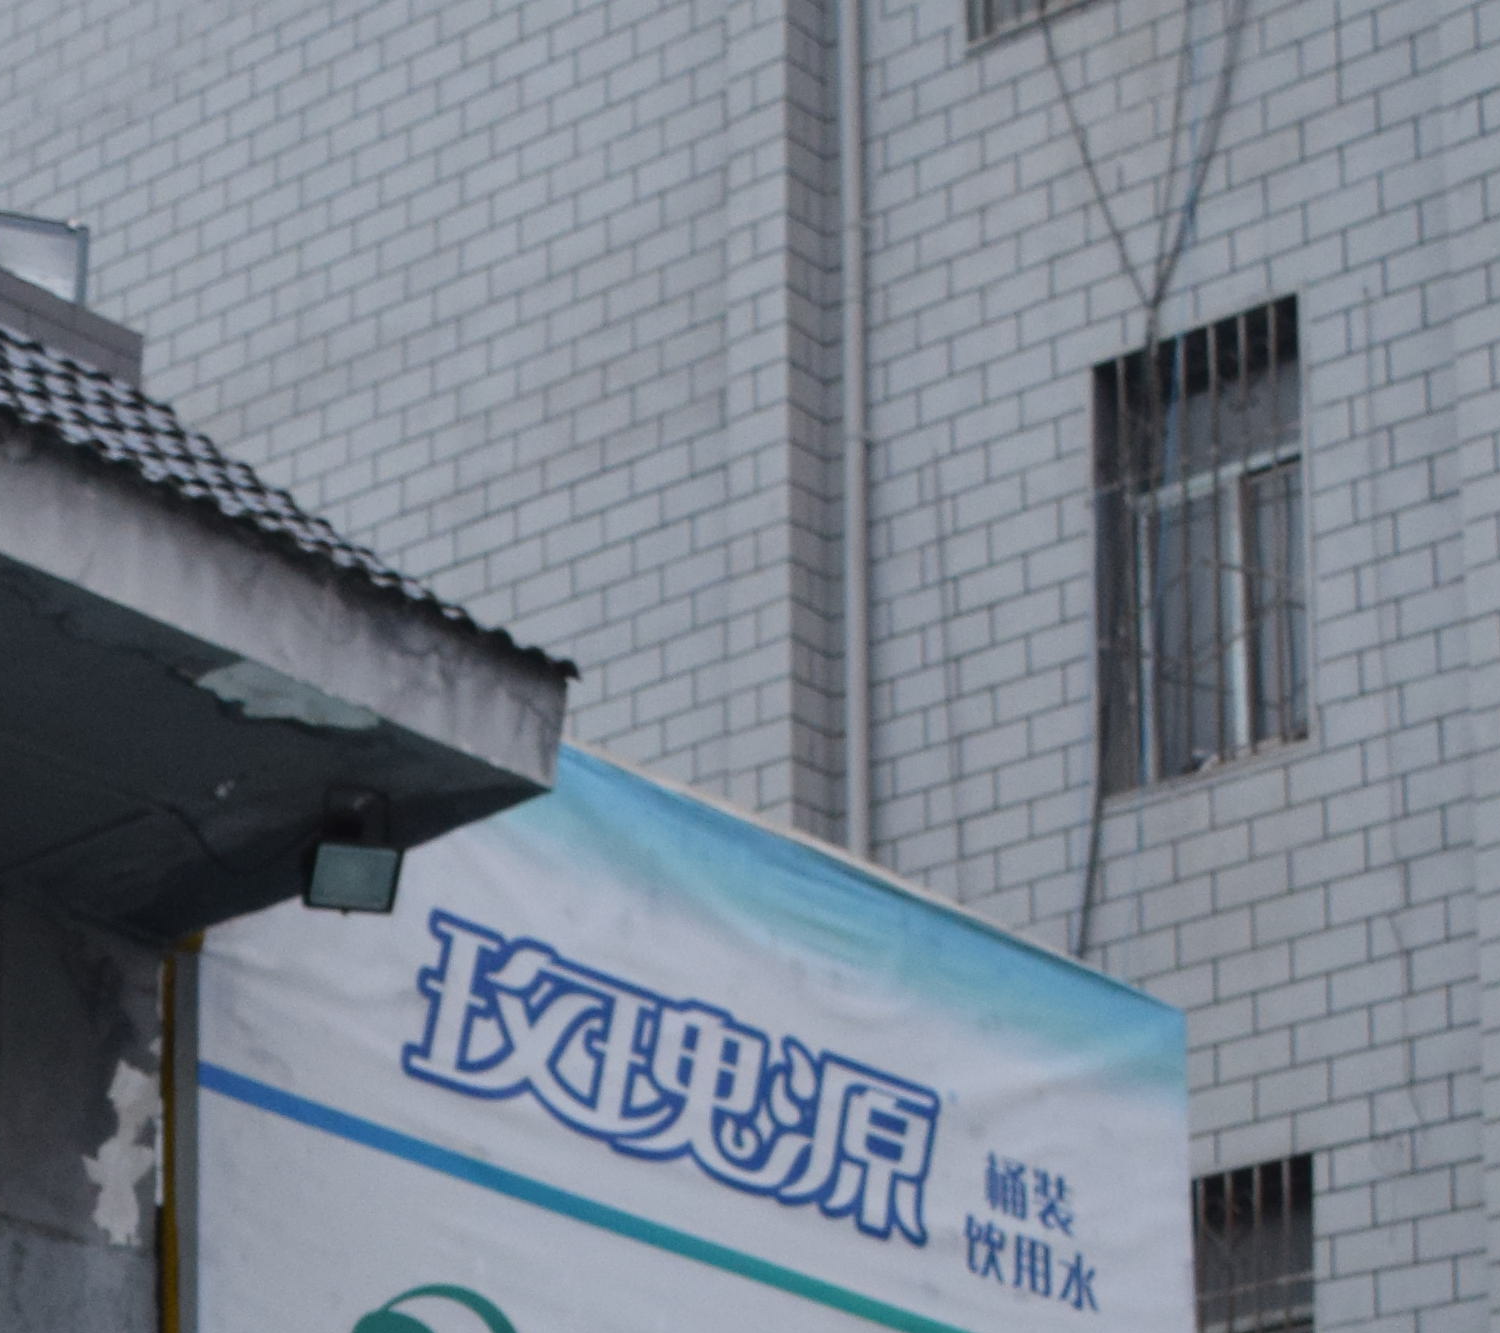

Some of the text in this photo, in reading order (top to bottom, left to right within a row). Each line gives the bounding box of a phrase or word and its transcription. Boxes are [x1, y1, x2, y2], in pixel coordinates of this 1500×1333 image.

[402, 907, 942, 1248] 玫瑰源
[984, 1150, 1076, 1238] 桶装
[965, 1213, 1100, 1312] 饮用水
